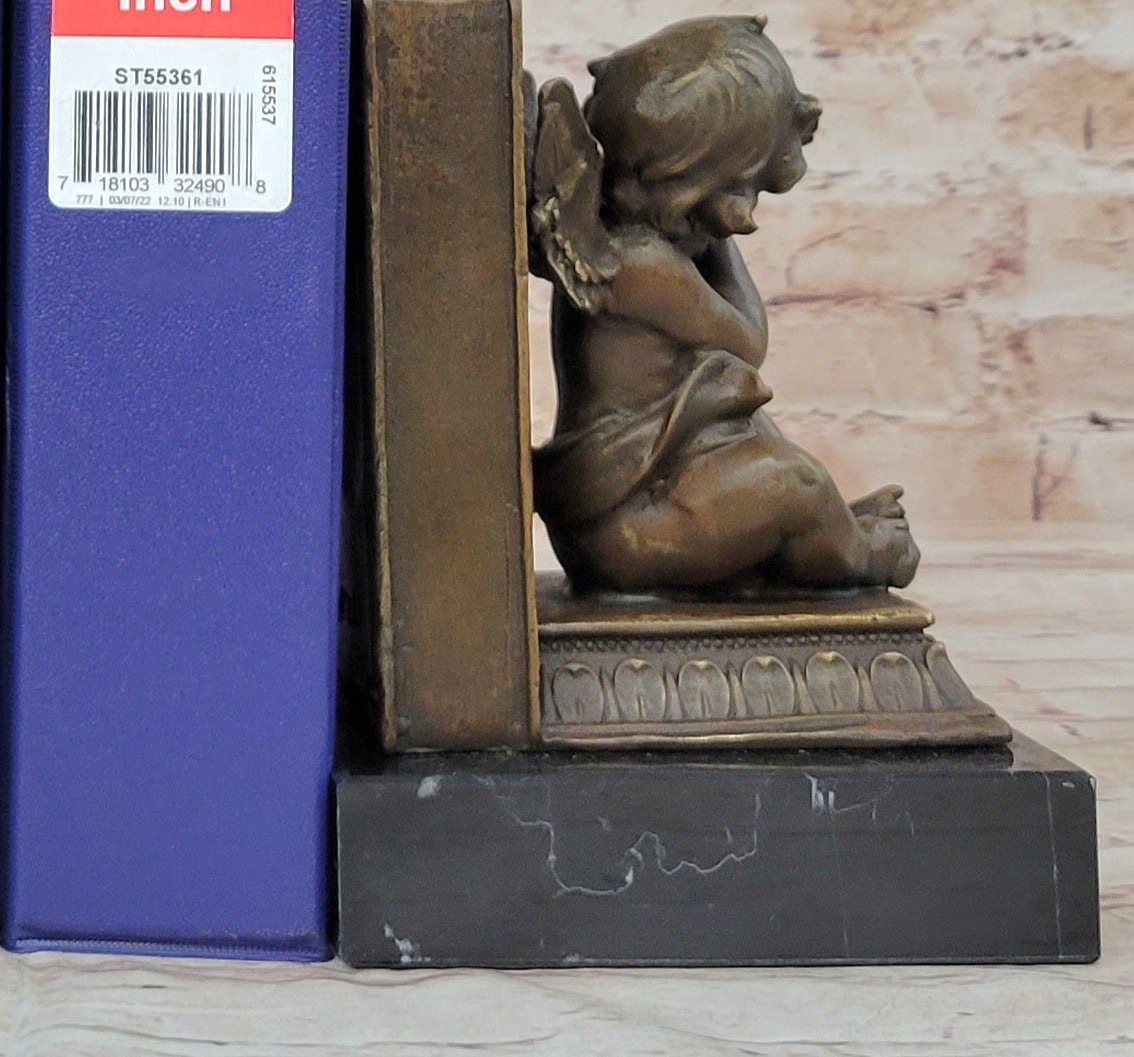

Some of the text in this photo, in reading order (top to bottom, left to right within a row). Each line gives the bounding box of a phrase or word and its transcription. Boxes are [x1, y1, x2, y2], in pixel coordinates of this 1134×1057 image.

[114, 67, 203, 85] ST55361
[262, 64, 277, 126] 615537
[57, 175, 266, 194] 7 18103 32490 8
